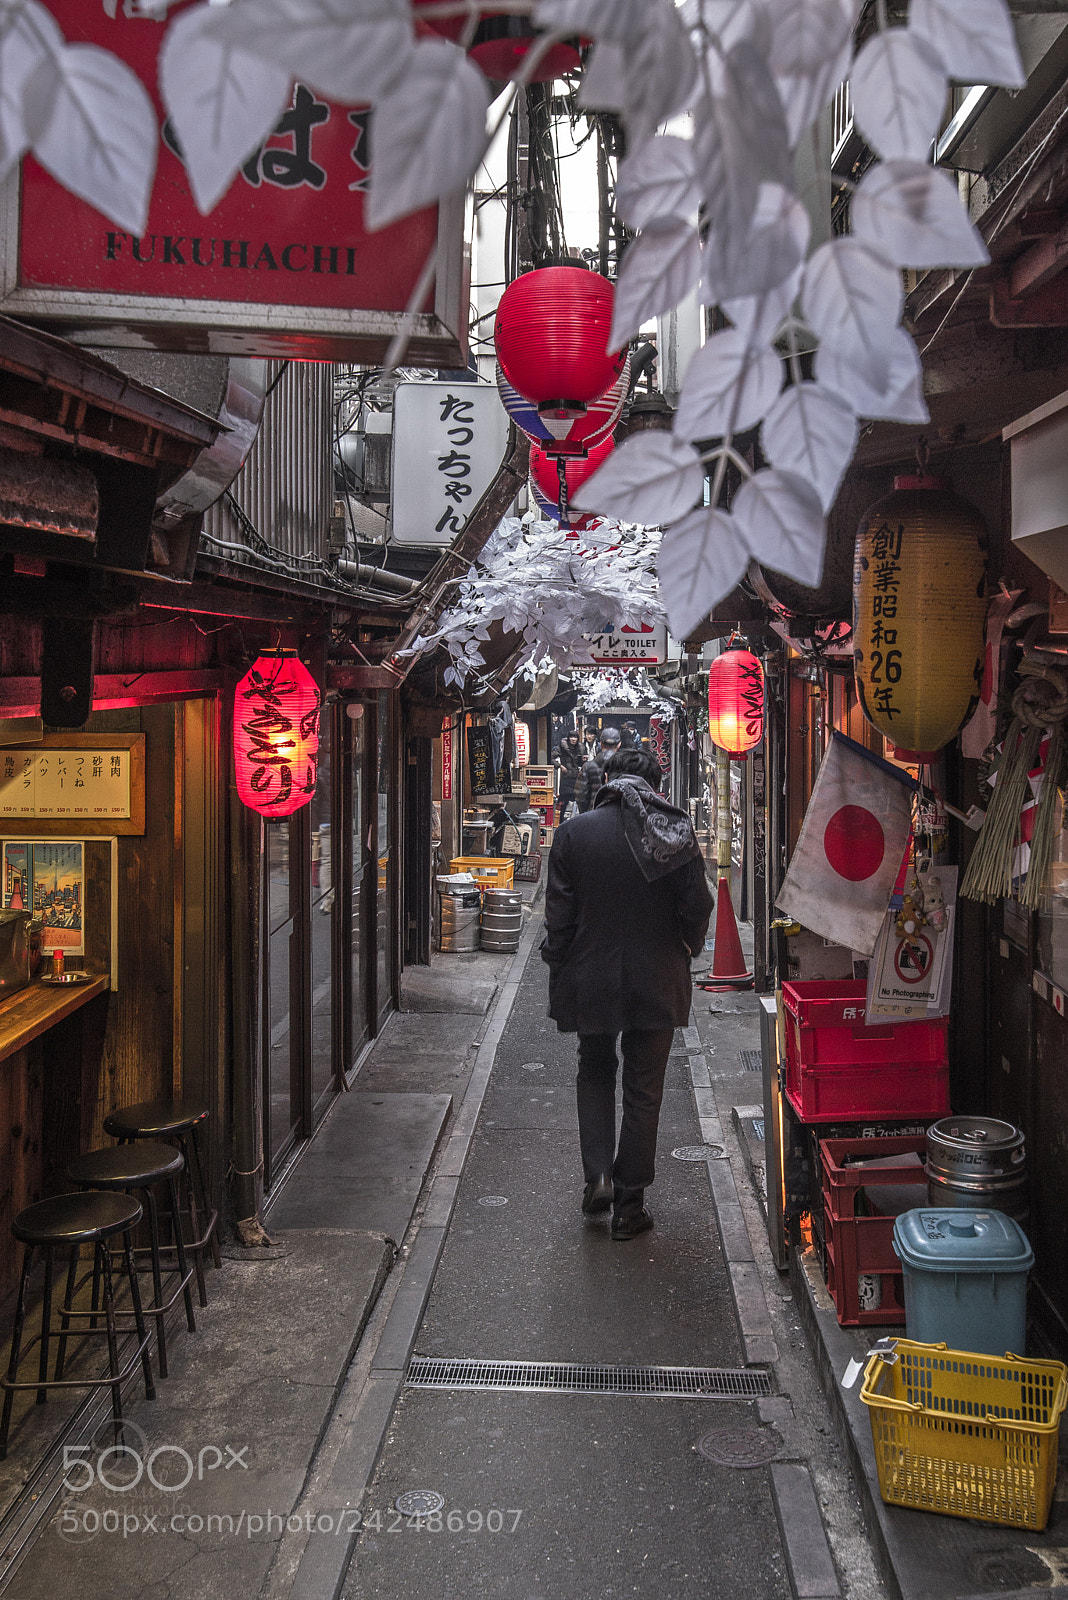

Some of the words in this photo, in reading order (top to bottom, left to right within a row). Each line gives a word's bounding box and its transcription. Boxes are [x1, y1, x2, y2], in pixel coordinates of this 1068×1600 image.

[103, 231, 358, 276] FUKUHACHI
[435, 393, 475, 534] たっちゃん
[870, 522, 904, 721] 創業昭和26年
[624, 639, 657, 648] TOILET
[23, 757, 32, 789] カシラ
[39, 757, 49, 777] ハツ
[57, 757, 67, 788] レバー
[74, 757, 85, 788] つくね
[92, 755, 103, 777] 砂肝
[110, 755, 121, 777] 精肉
[892, 989, 935, 999] Photographing
